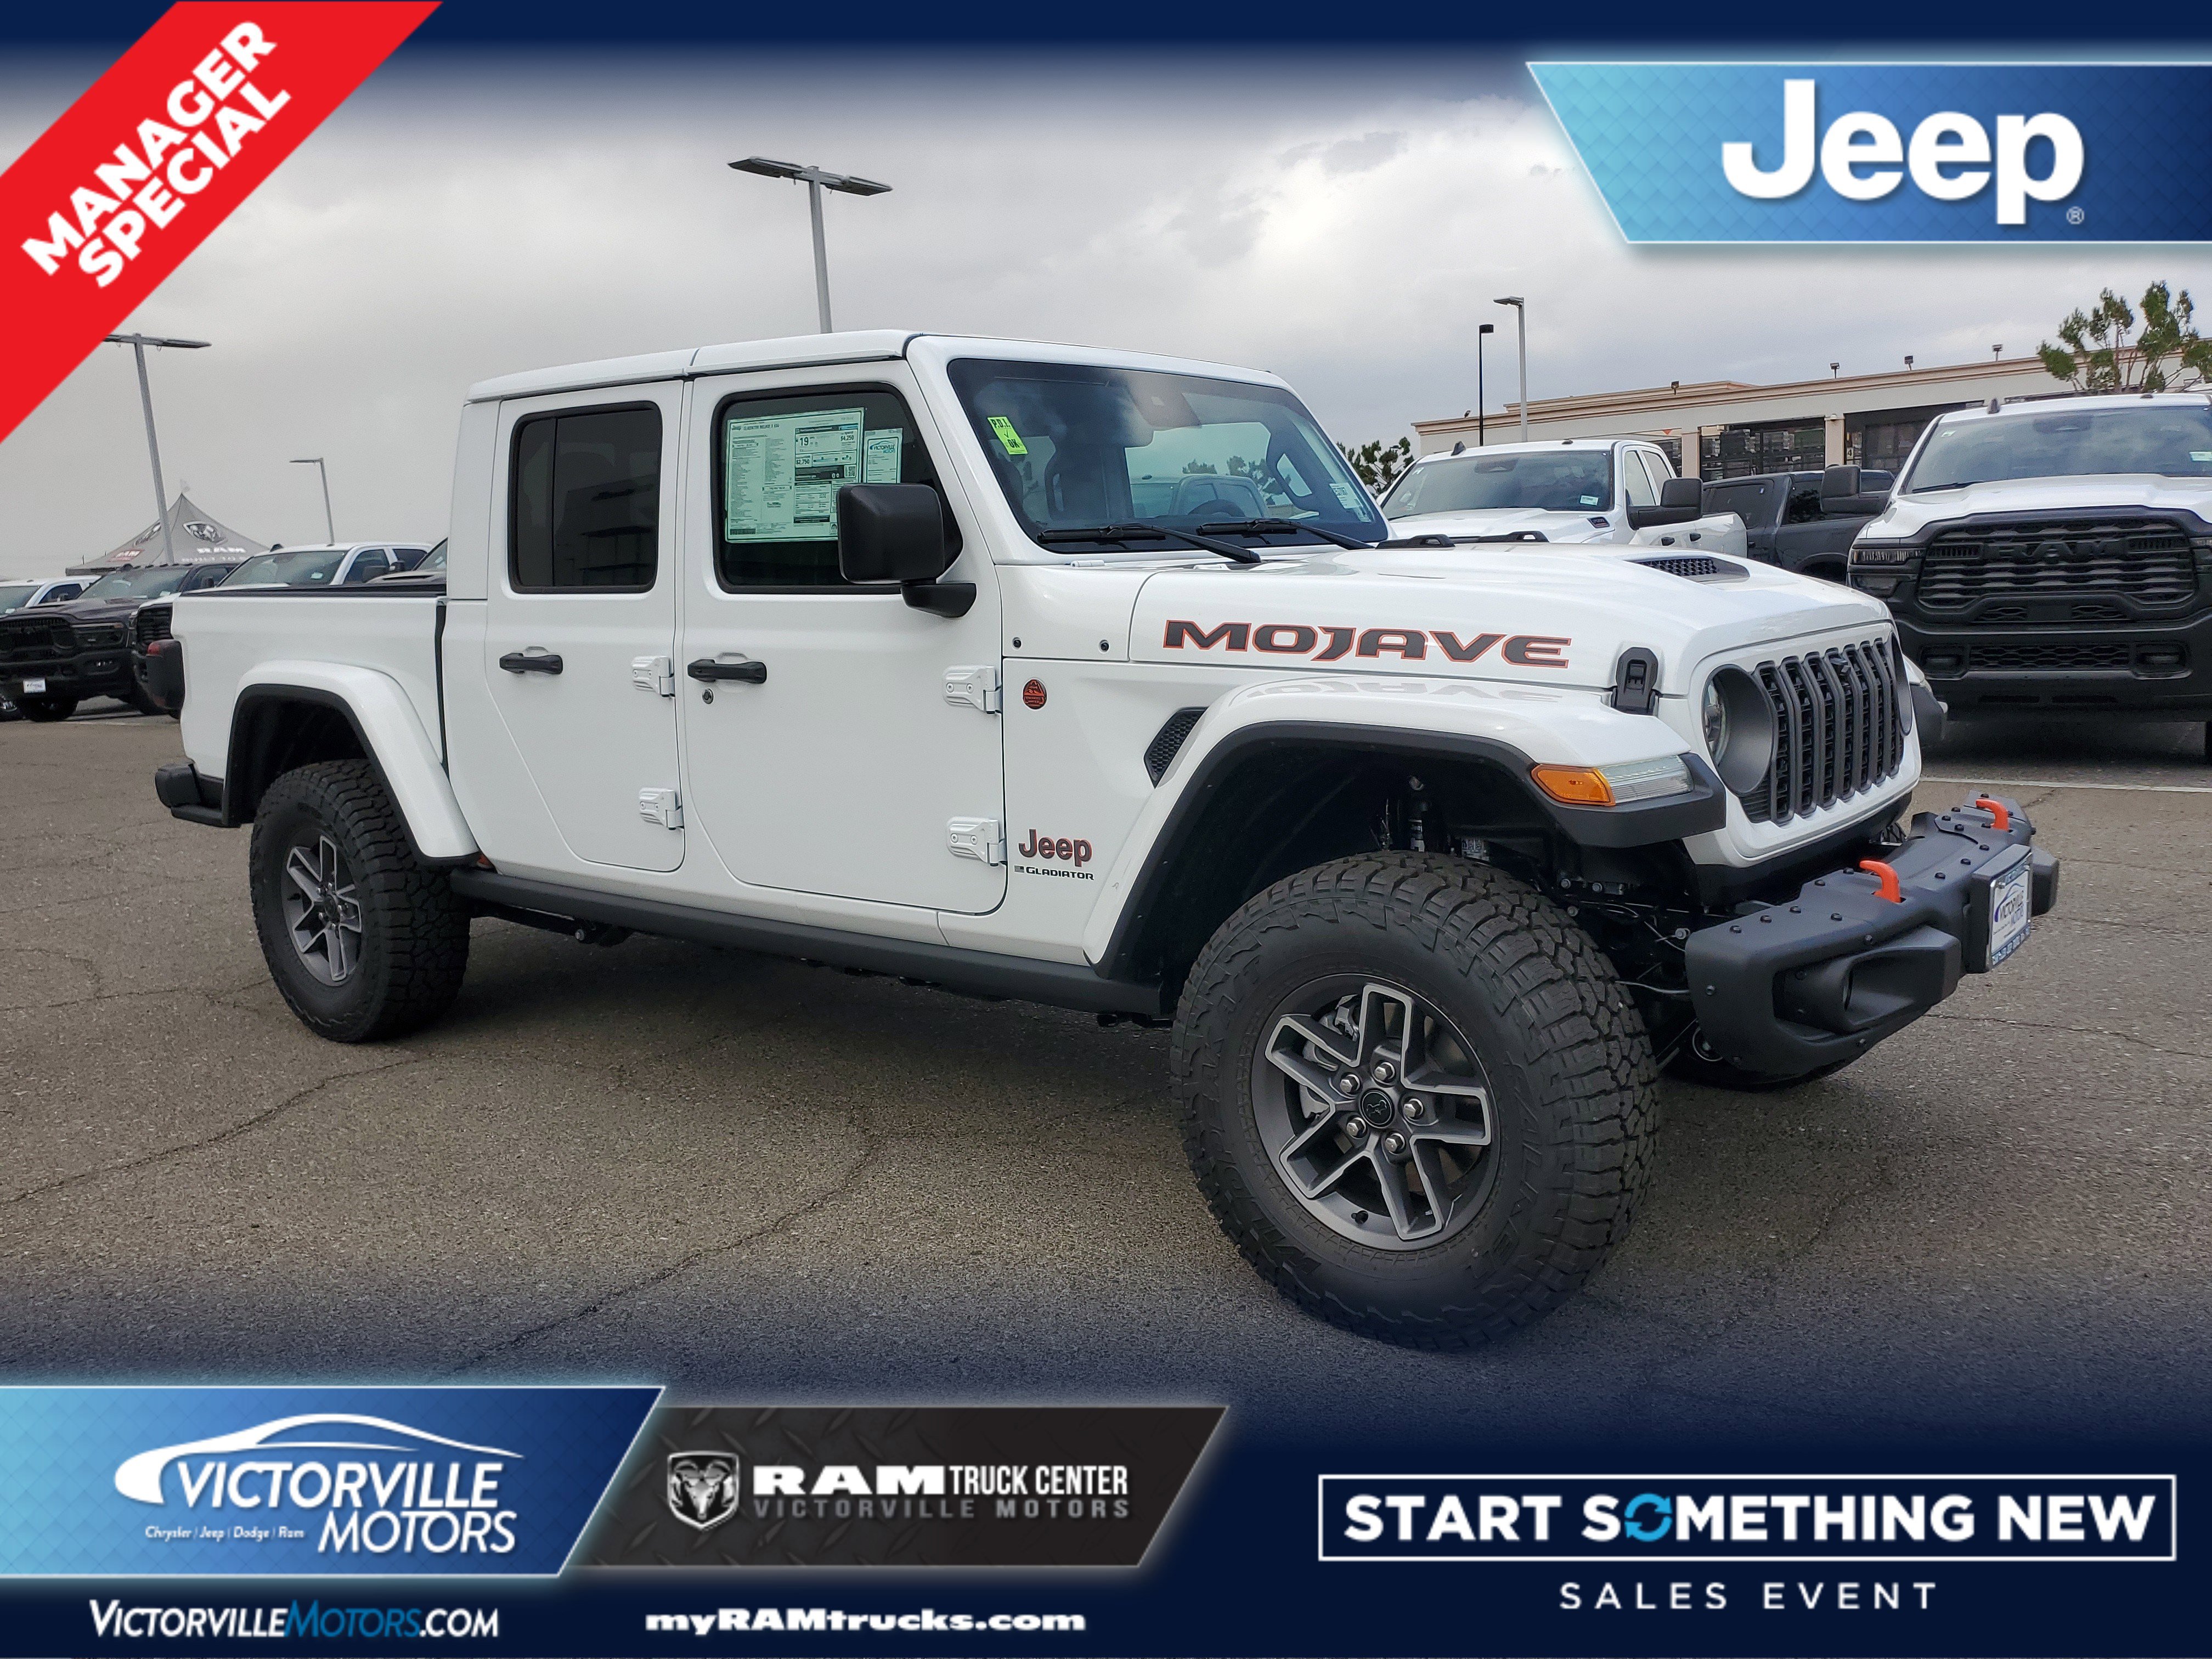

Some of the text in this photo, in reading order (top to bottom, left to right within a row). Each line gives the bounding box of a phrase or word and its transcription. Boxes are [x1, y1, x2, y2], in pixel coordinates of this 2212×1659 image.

[990, 419, 1011, 428] P.D.I.
[800, 437, 809, 446] 19
[1007, 439, 1020, 448] OK
[1163, 619, 1572, 669] MOJAVE
[1019, 829, 1092, 867] Jeep
[1026, 866, 1094, 880] GLADIATOR
